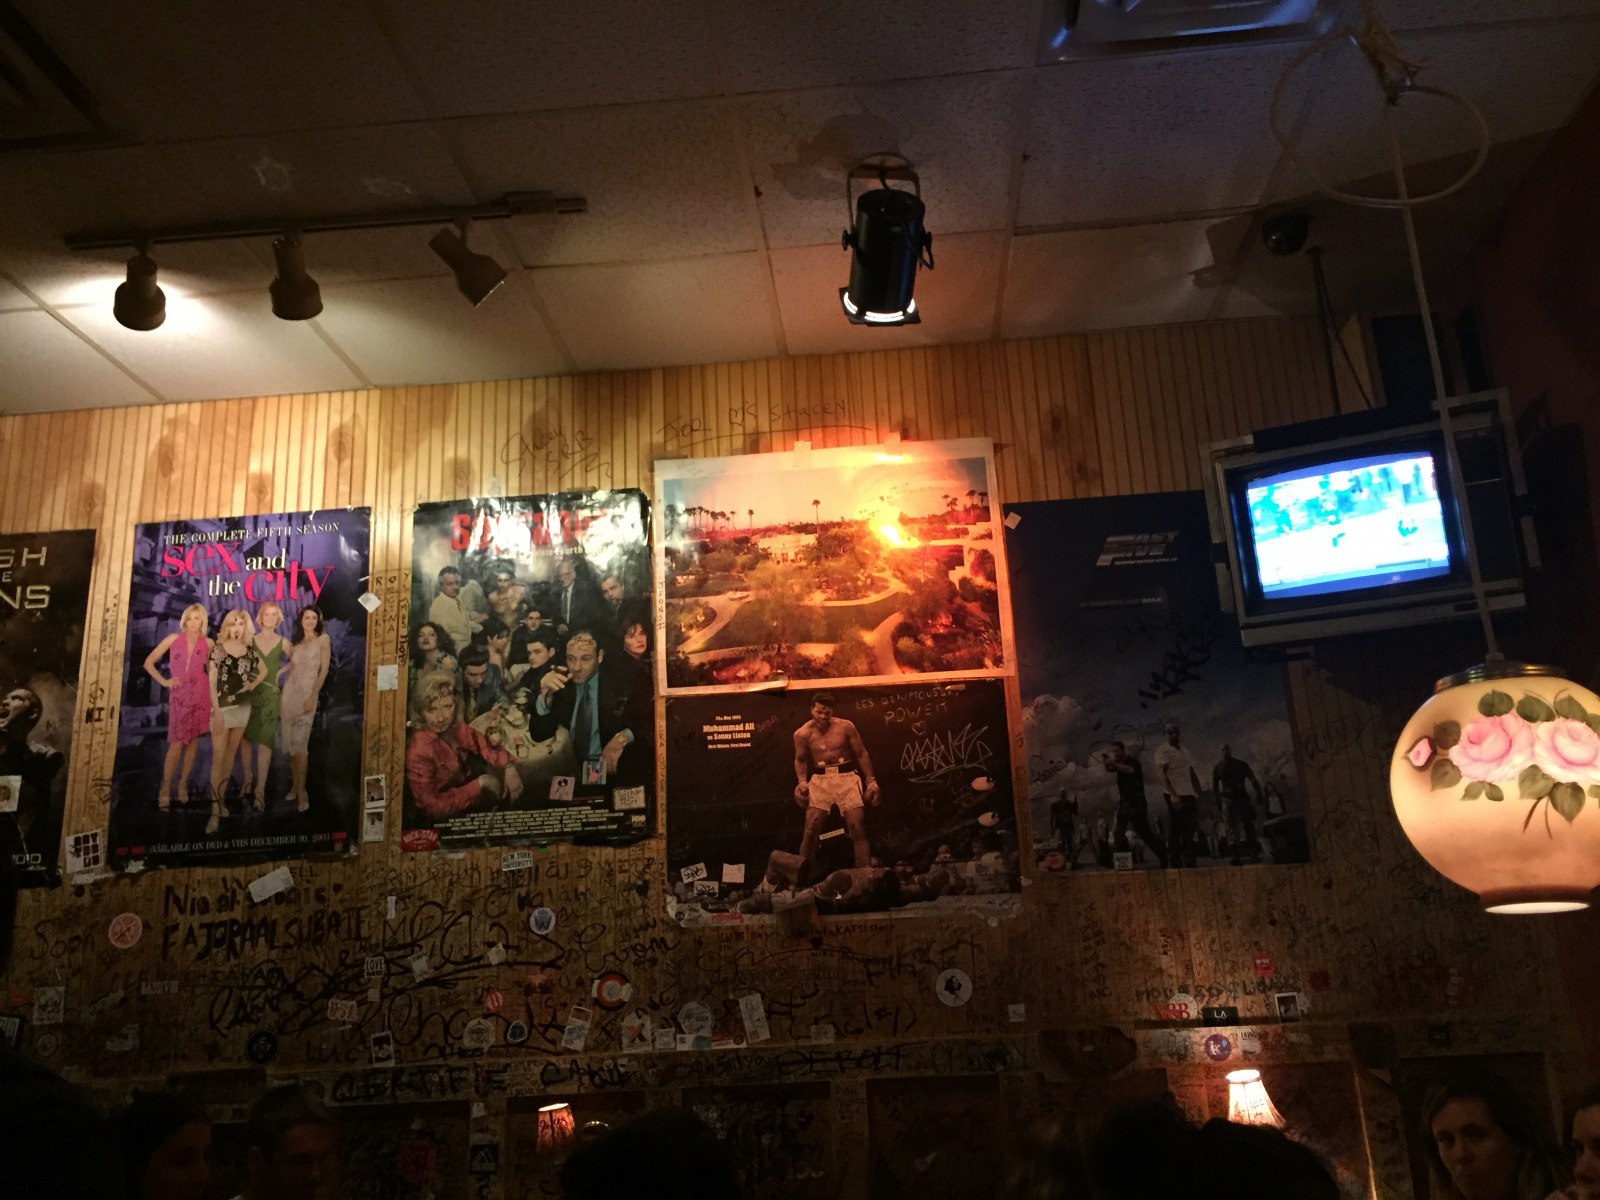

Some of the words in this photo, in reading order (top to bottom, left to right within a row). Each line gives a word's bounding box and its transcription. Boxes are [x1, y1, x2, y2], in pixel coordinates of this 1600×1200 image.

[164, 532, 187, 545] THE
[191, 529, 252, 542] COMPLETE
[257, 525, 292, 538] FIFTH
[296, 521, 340, 535] SEASON
[161, 541, 242, 577] sex
[245, 548, 286, 571] and
[208, 574, 241, 596] the
[244, 560, 335, 613] city
[702, 723, 744, 733] Muhammad
[745, 722, 755, 731] Ali
[192, 842, 203, 850] ON
[205, 840, 223, 850] DVD
[232, 838, 249, 848] VHS
[250, 835, 296, 847] DECEMBER
[503, 852, 515, 862] NEW
[516, 851, 532, 859] YORK
[503, 859, 532, 870] UNIVERSITY
[366, 958, 388, 972] LOVE
